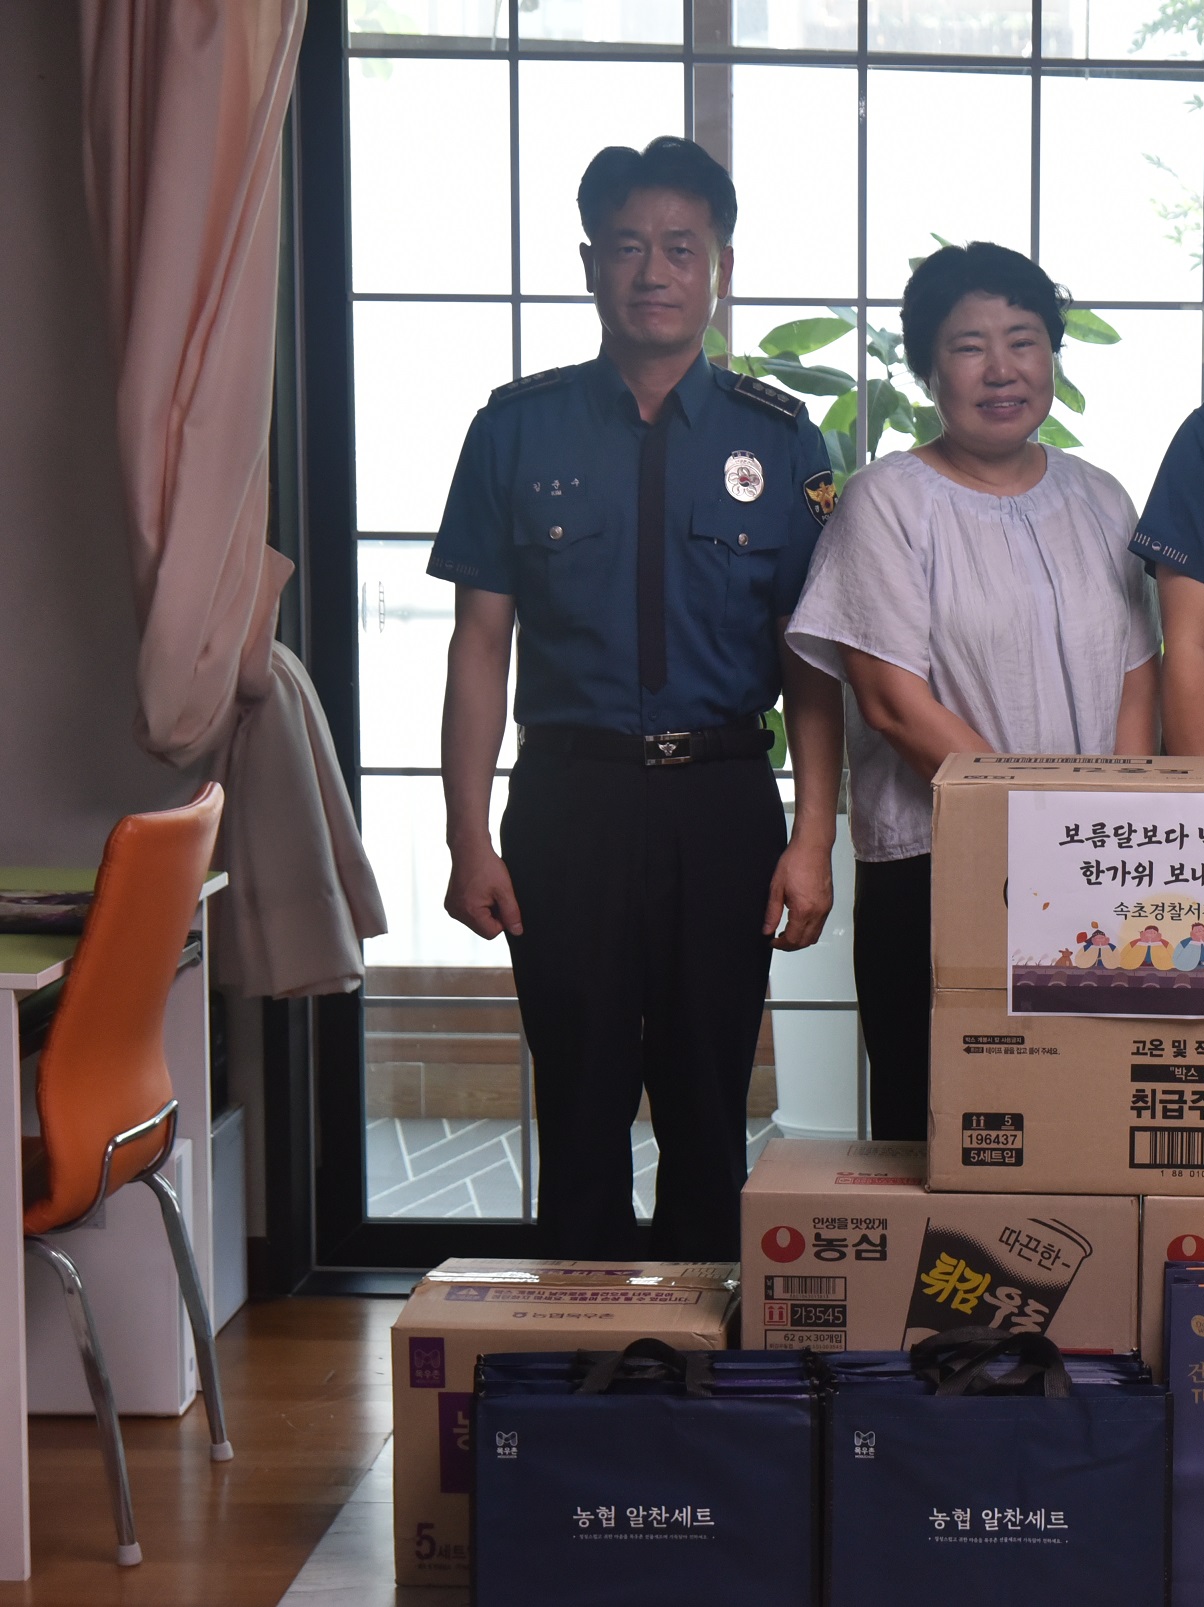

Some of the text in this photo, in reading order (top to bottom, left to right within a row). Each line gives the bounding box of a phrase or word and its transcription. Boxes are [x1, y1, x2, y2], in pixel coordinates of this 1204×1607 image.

[1058, 822, 1189, 850] 보름달보다
[1079, 859, 1154, 887] 한가위
[1130, 1039, 1165, 1058] 고온
[1172, 1040, 1187, 1059] 및
[1170, 1067, 1199, 1082] "박스
[1003, 1115, 1012, 1126] 5
[967, 1133, 1018, 1146] 196437
[970, 1150, 1016, 1163] 5세트입
[812, 1217, 888, 1231] 인생을 맛있게
[811, 1233, 888, 1262] 농심
[920, 1251, 992, 1314] 튀김
[793, 1306, 843, 1323] 가3545
[572, 1505, 715, 1529] 농협 알찬세트
[928, 1507, 1069, 1531] 농협 알찬세트
[415, 1522, 471, 1560] 5세트
